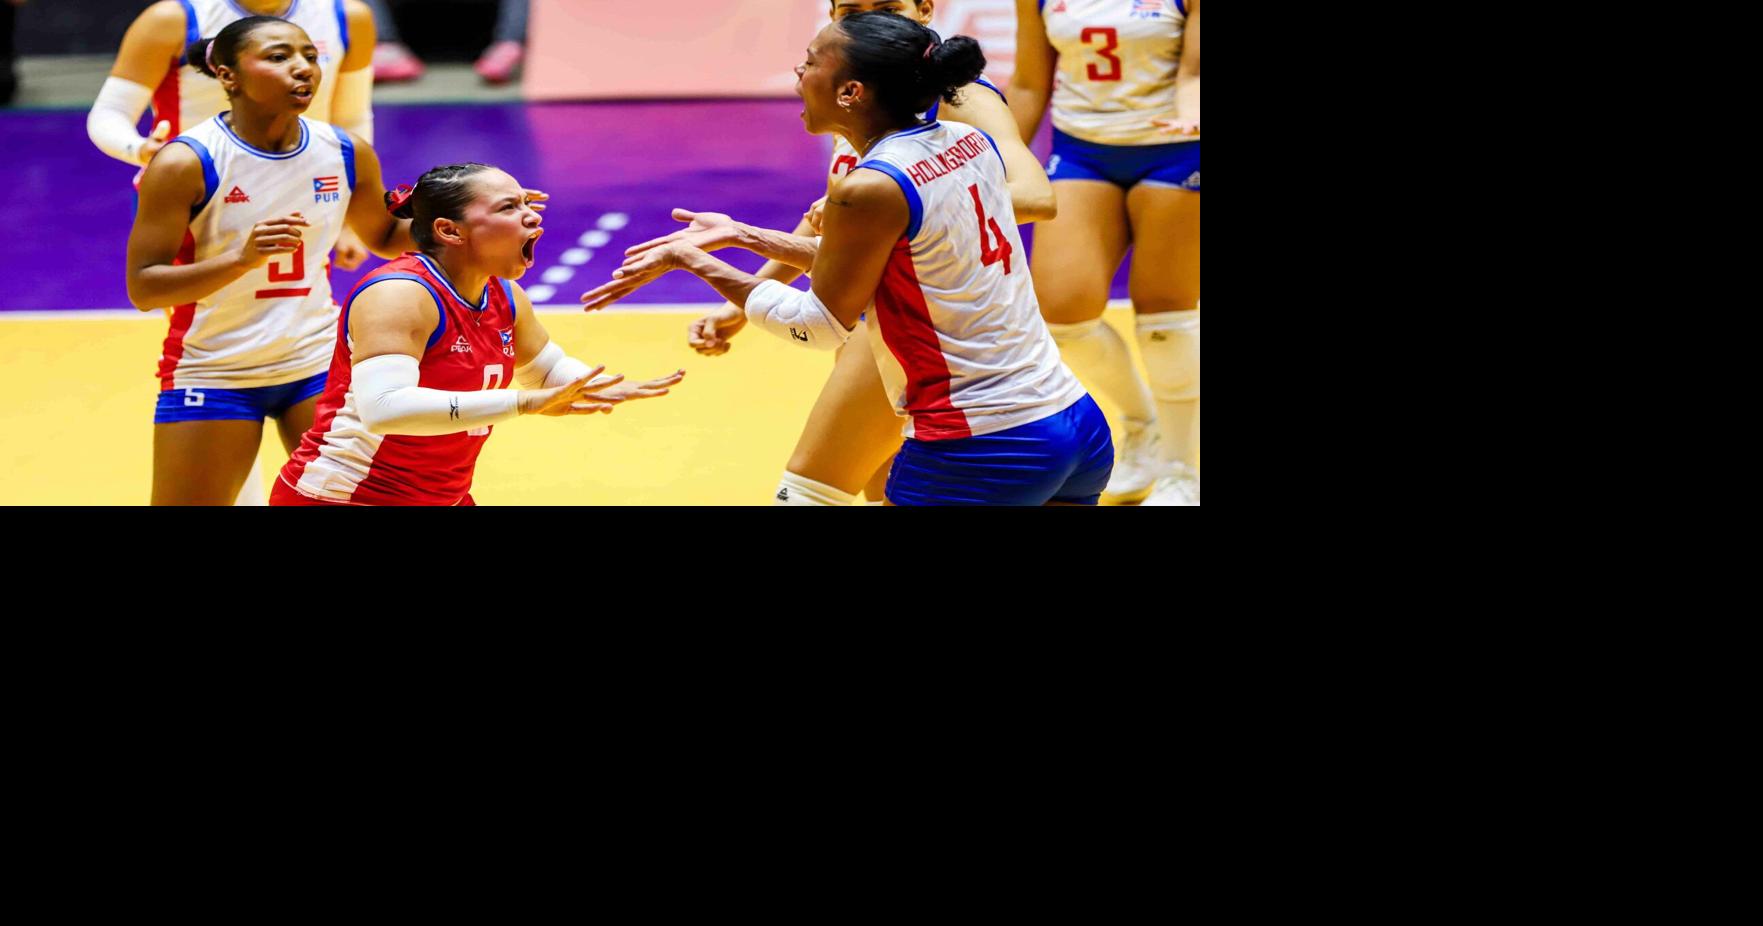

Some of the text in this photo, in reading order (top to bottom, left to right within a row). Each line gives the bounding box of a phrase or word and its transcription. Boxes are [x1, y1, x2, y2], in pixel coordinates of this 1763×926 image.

[1081, 27, 1122, 82] 3
[314, 192, 340, 203] PUR
[967, 183, 1013, 276] 4
[184, 388, 205, 407] 5
